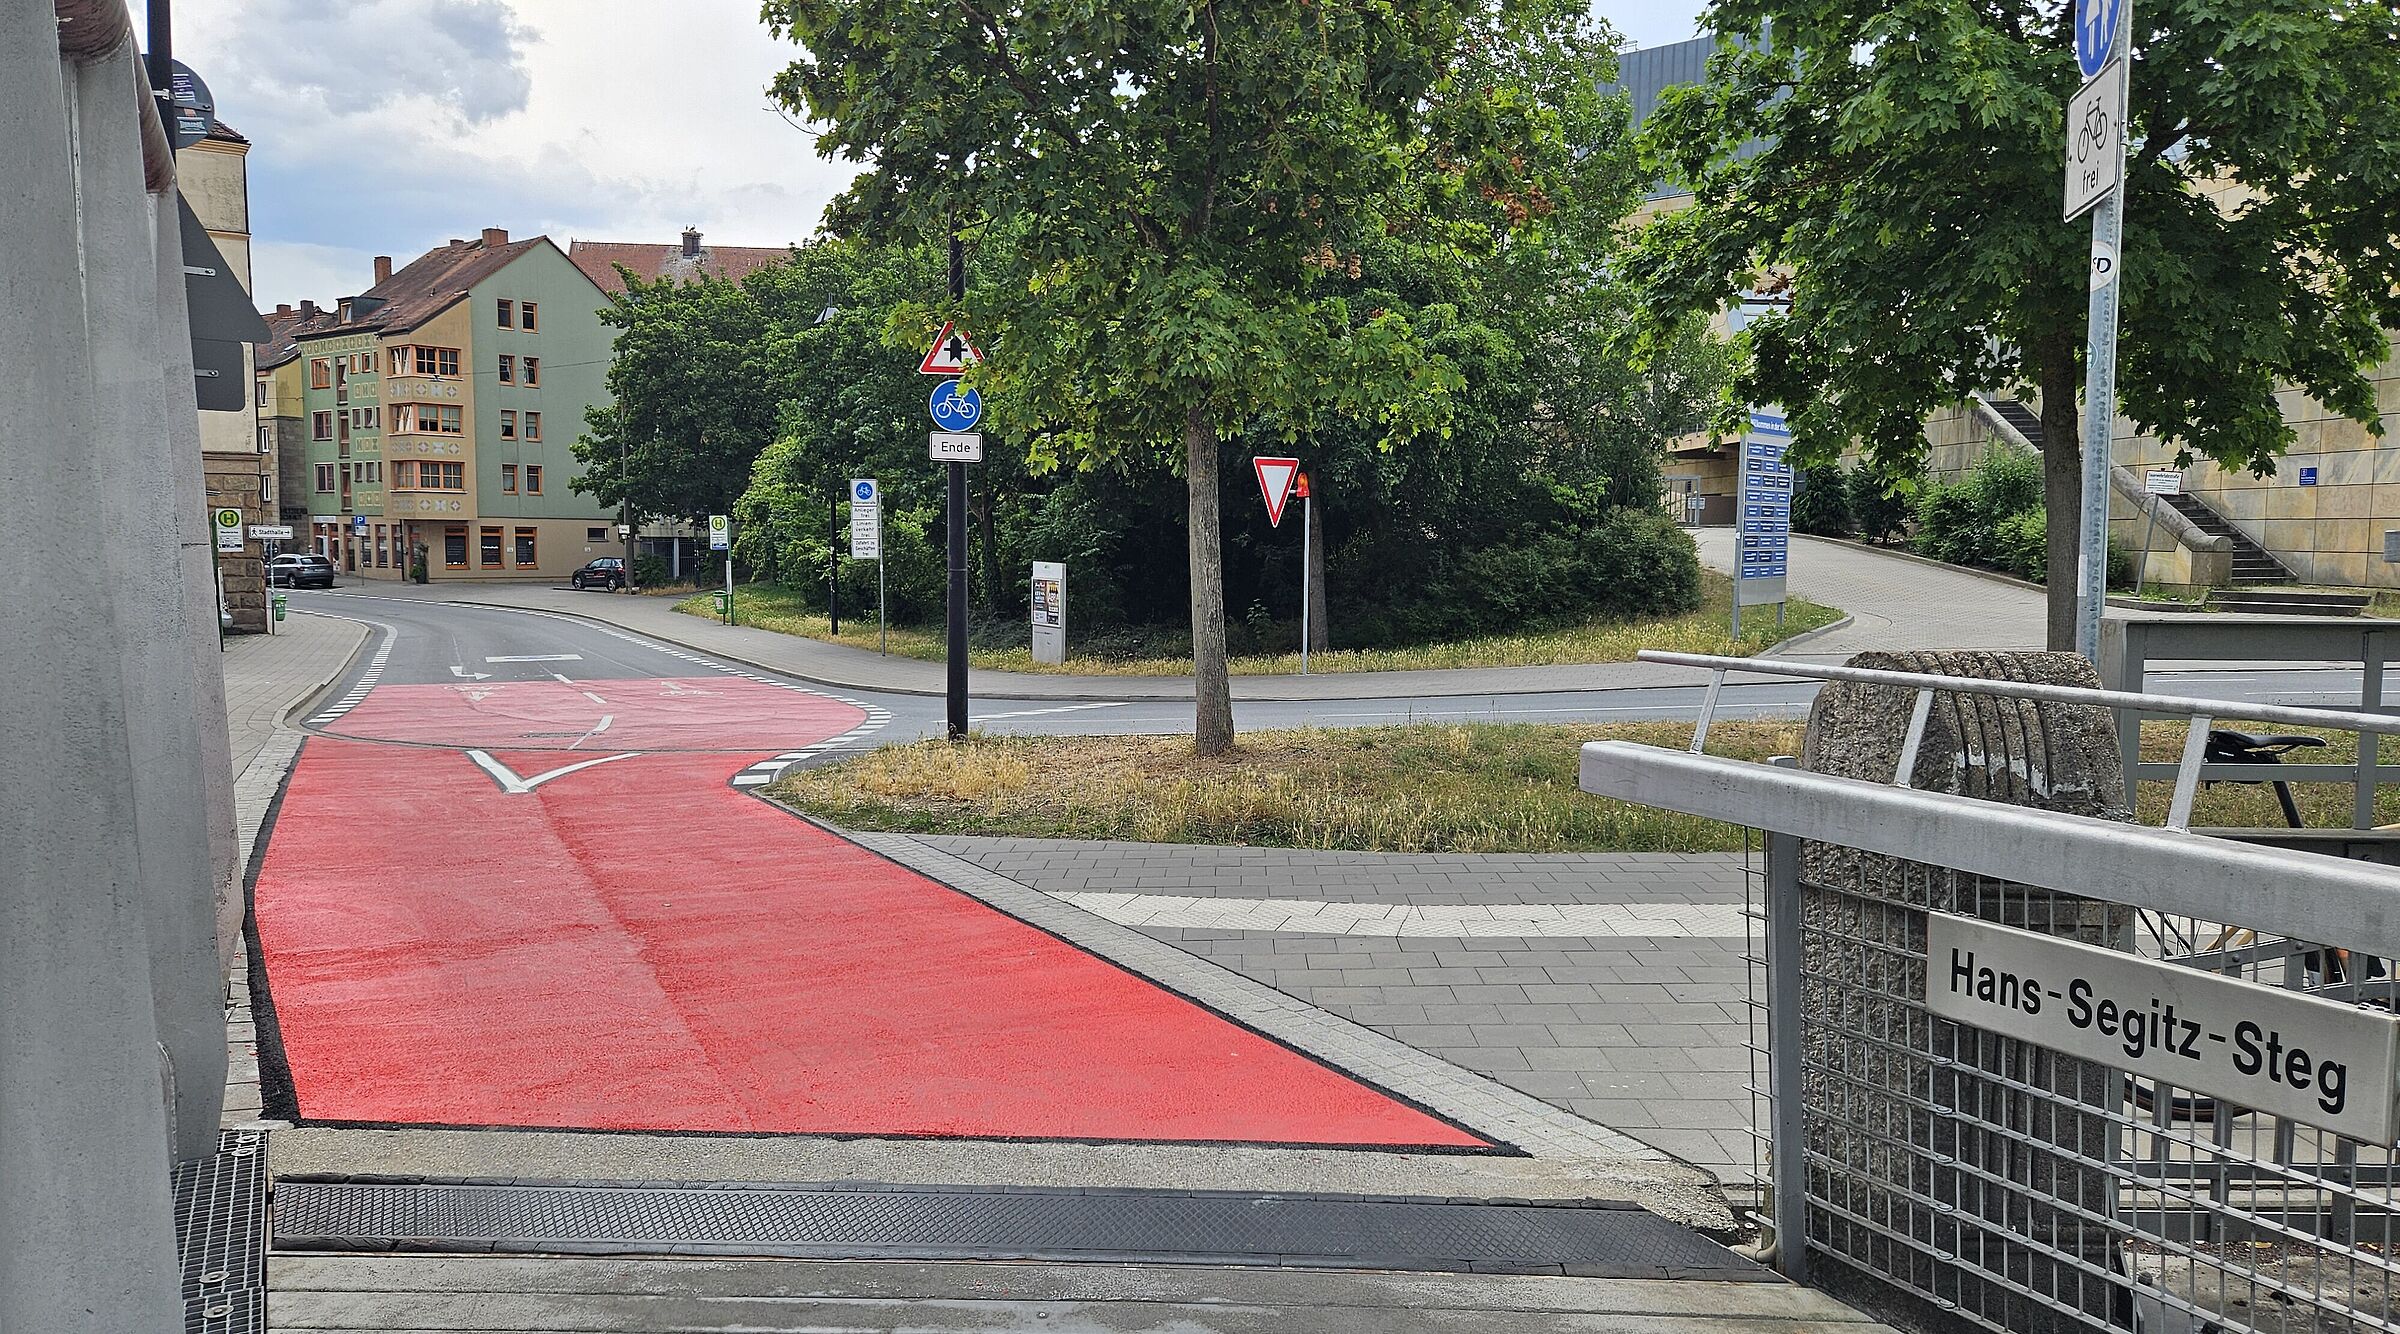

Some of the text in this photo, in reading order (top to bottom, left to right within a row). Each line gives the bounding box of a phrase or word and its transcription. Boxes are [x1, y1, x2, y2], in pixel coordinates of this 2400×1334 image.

[2082, 161, 2100, 195] frei
[941, 441, 971, 453] Ende
[223, 513, 235, 524] H
[356, 516, 364, 524] P
[1950, 947, 2347, 1115] Hans-Segitz-Steg
